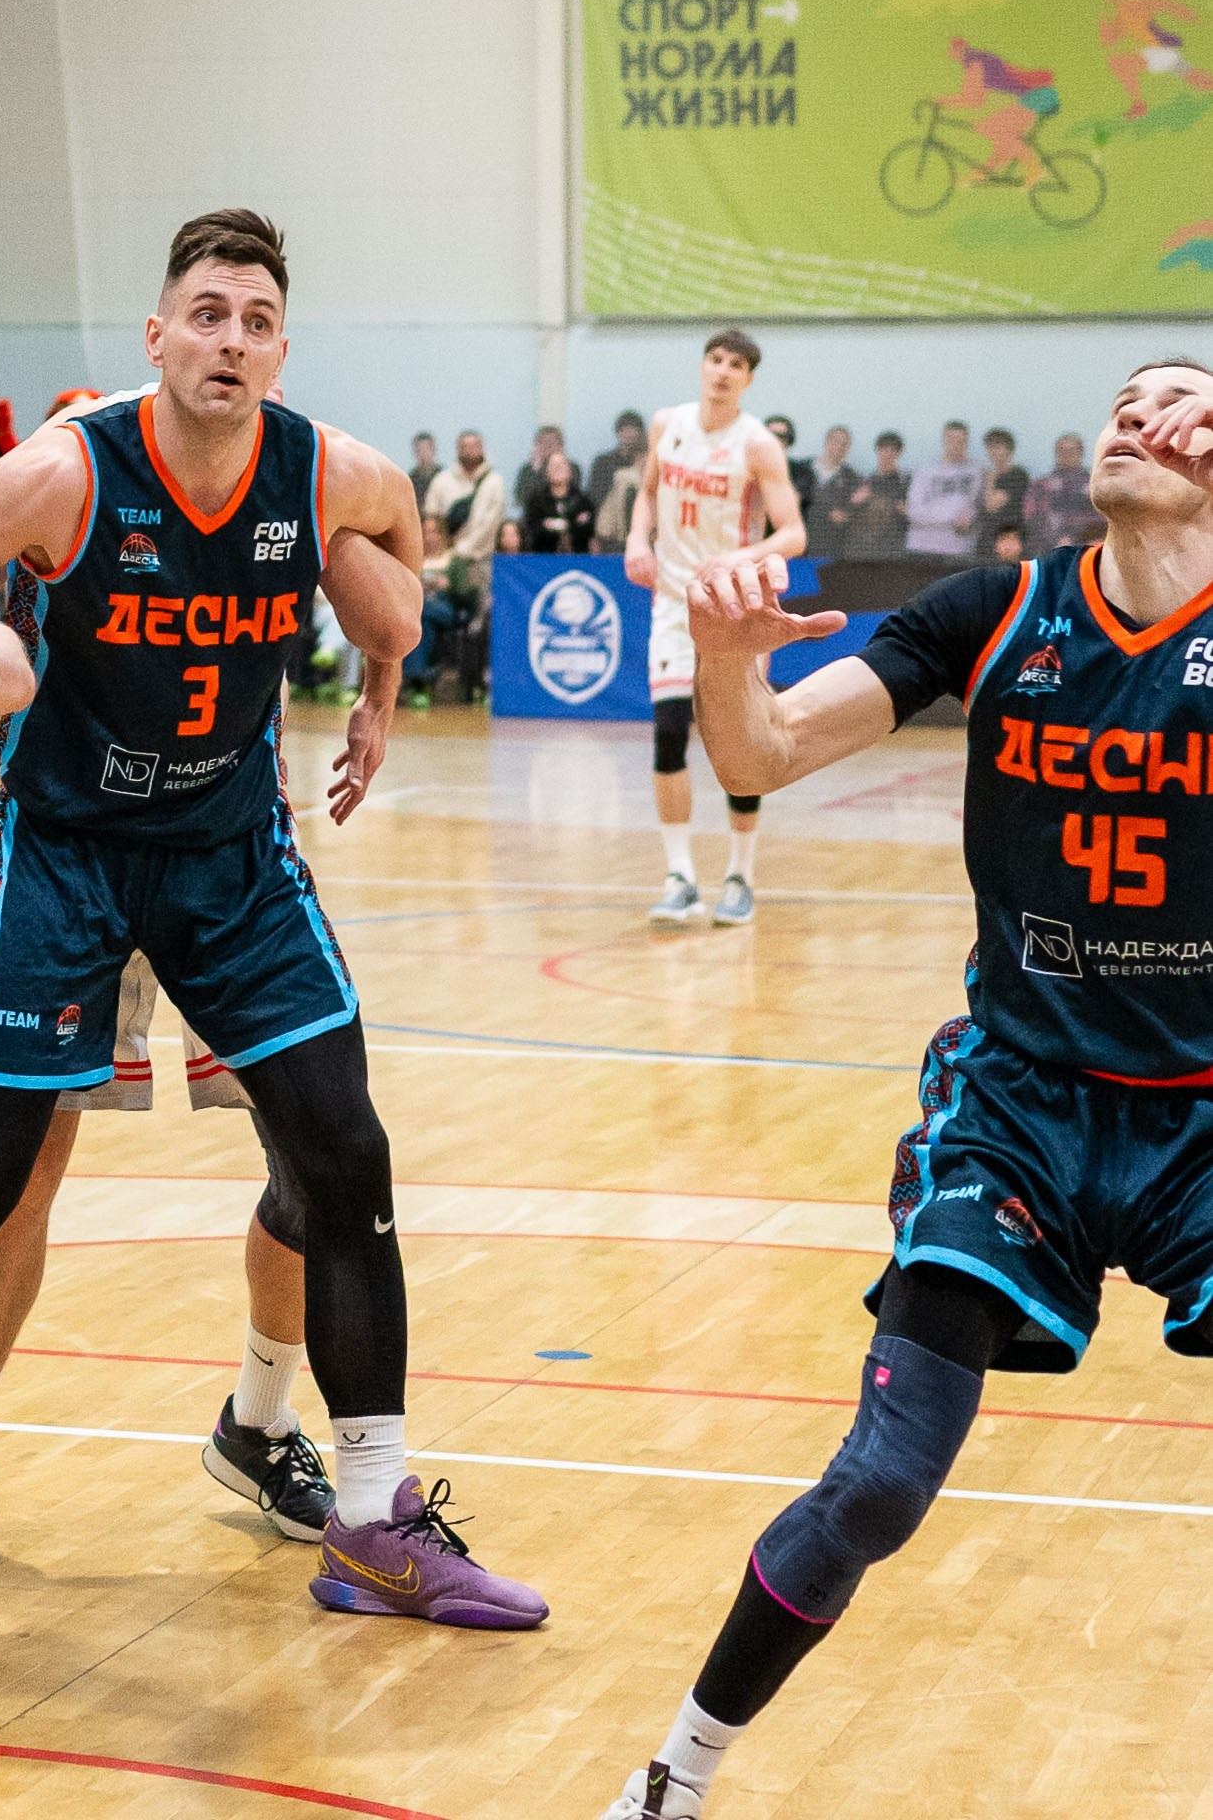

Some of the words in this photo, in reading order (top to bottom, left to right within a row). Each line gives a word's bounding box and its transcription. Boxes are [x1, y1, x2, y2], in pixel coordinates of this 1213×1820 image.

[620, 38, 796, 80] НОРМА
[622, 87, 796, 128] ЖИЗНИ
[117, 507, 162, 525] TEAM
[253, 520, 298, 541] FON
[254, 540, 296, 561] BET
[177, 665, 220, 736] 3
[994, 715, 1213, 796] ДЕСН
[1061, 812, 1168, 908] 45
[1085, 940, 1213, 960] НАДЕЖДА
[1092, 963, 1213, 976] ЕВЕЛОПМЕНТ
[936, 1184, 984, 1201] TEAM
